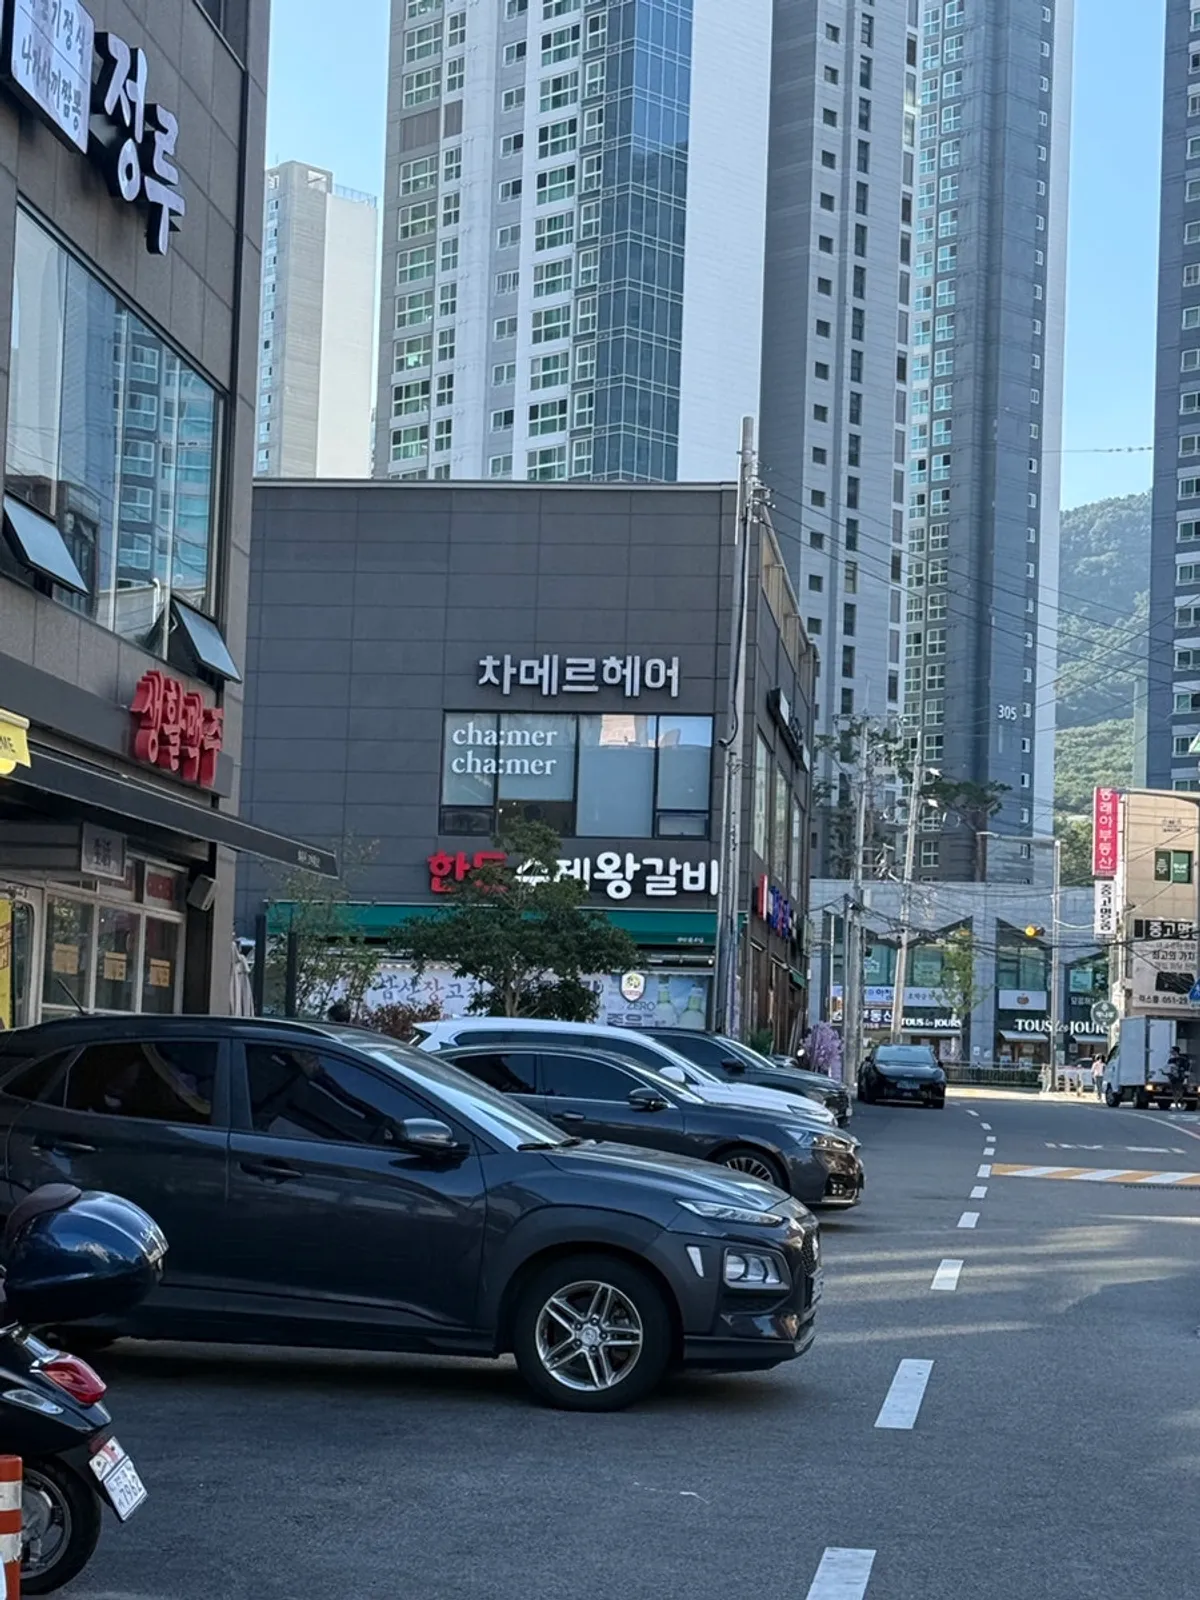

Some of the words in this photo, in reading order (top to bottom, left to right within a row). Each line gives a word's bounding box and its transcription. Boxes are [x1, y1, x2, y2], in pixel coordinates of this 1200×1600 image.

[478, 653, 681, 698] 차메르헤어
[997, 704, 1018, 720] 305
[130, 668, 225, 788] 생활맥주
[452, 721, 558, 747] cha:mer
[451, 750, 557, 775] cha:mer
[1015, 1018, 1053, 1032] TOUS
